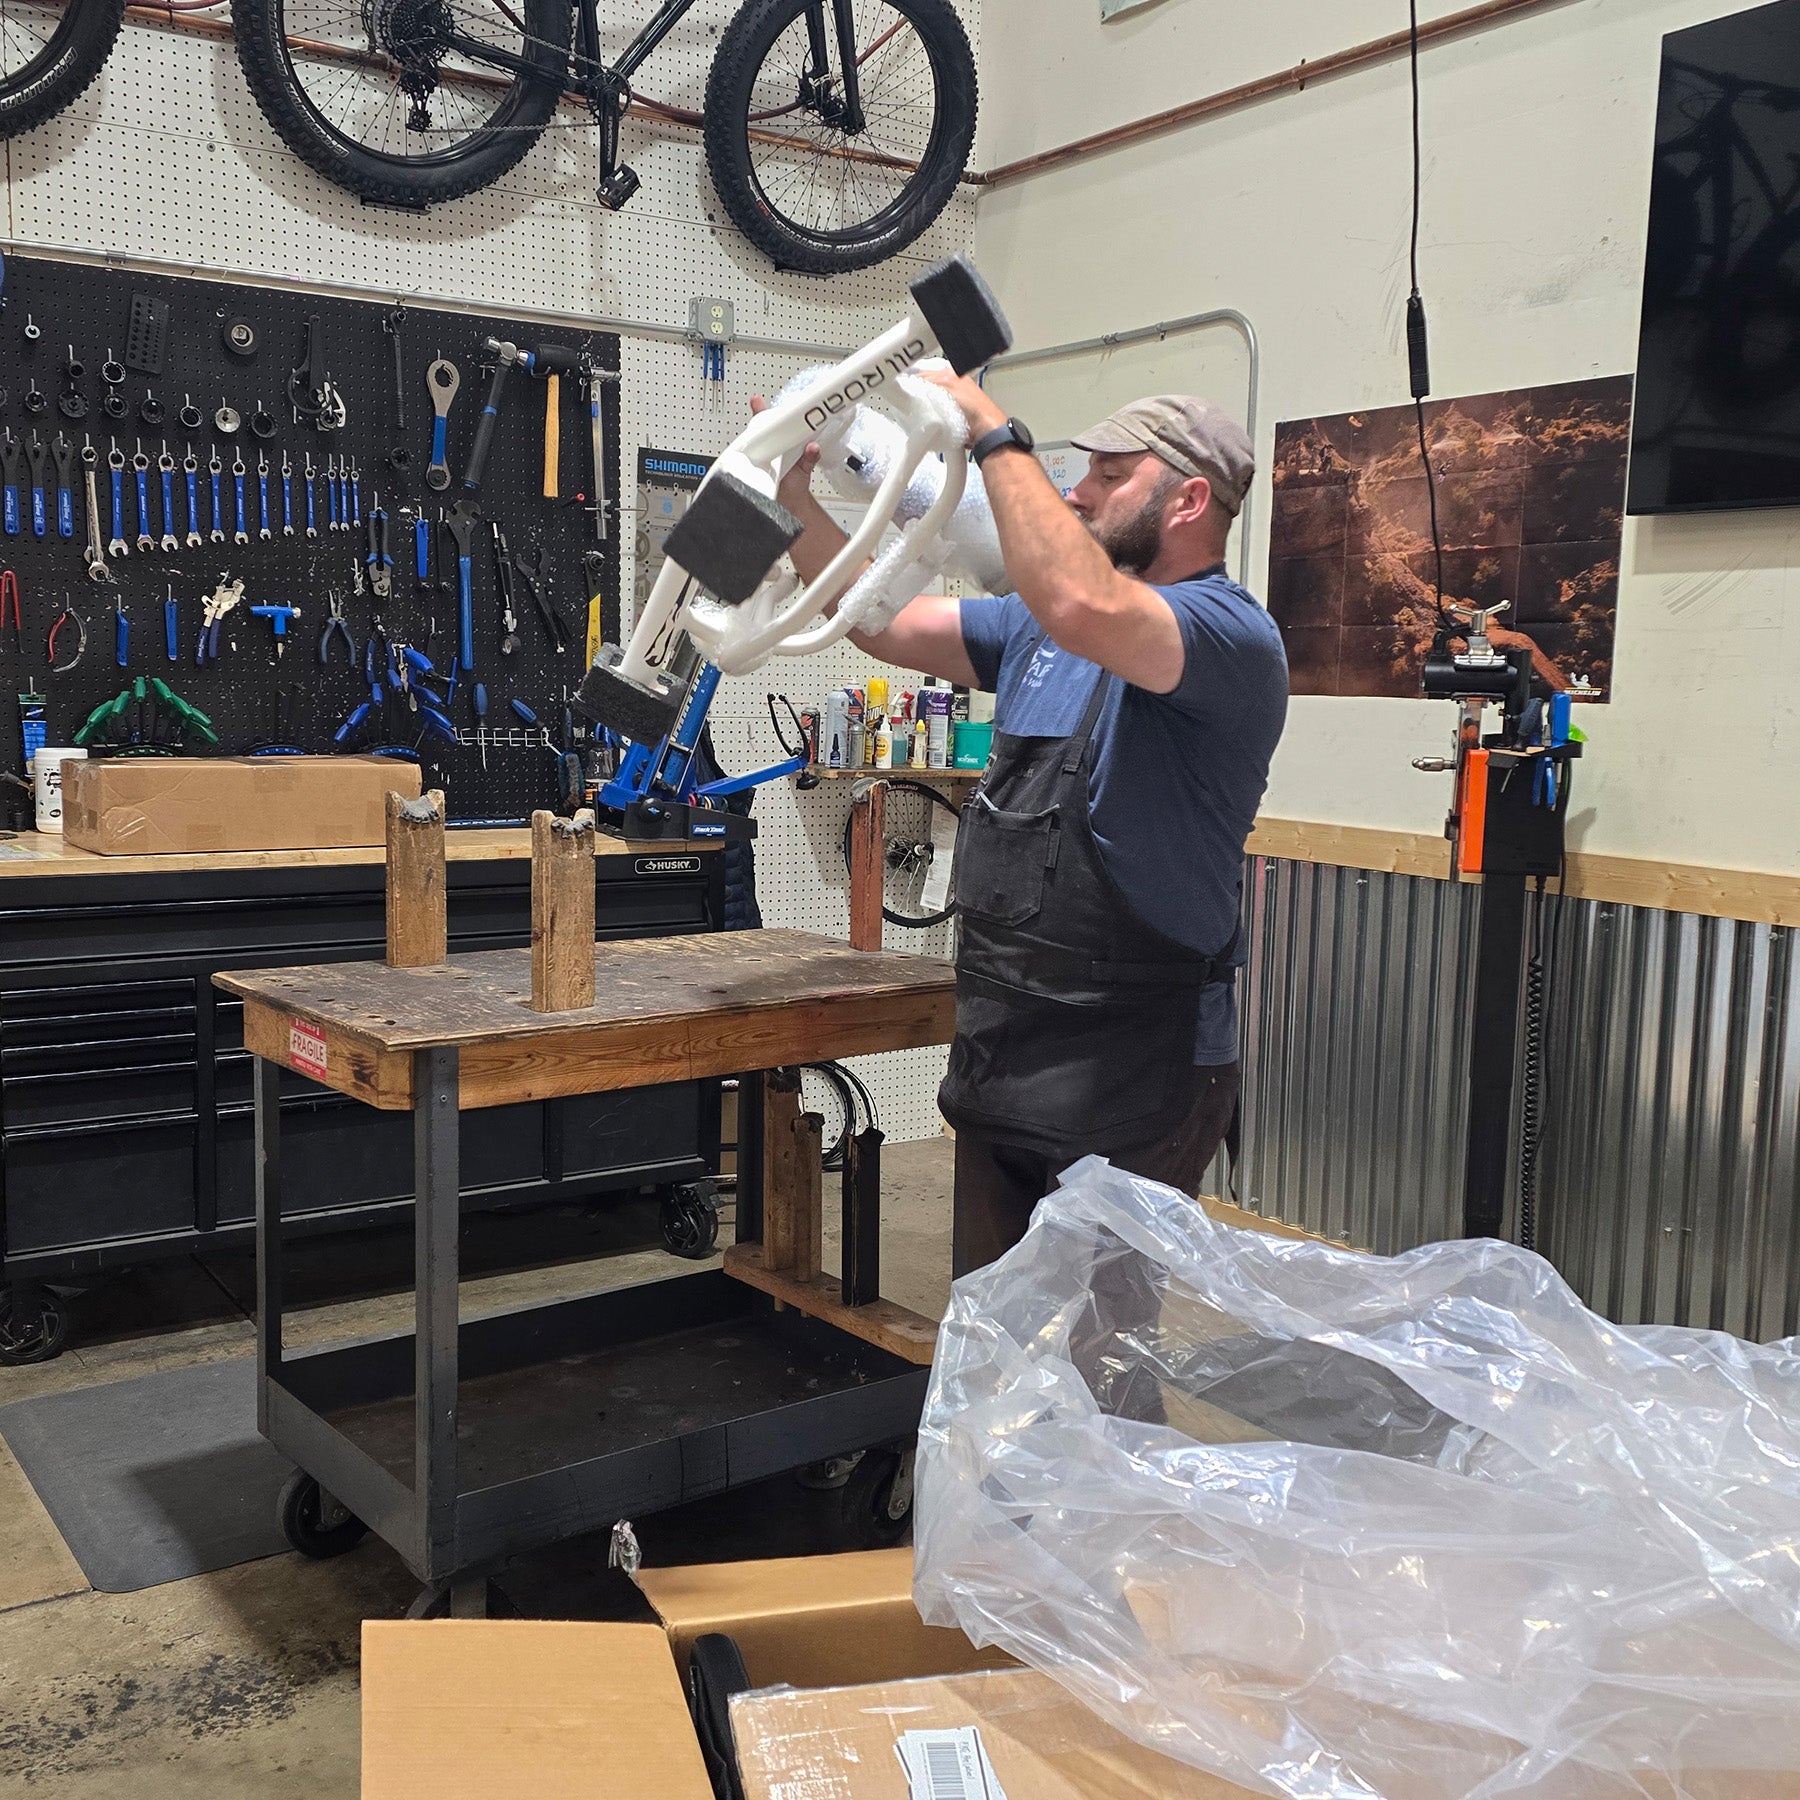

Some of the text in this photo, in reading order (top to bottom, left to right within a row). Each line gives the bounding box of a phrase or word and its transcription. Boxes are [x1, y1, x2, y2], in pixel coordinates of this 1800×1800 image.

[645, 458, 707, 476] SHIMANO
[657, 860, 690, 870] HUSKY
[292, 1033, 325, 1063] FRAGILE
